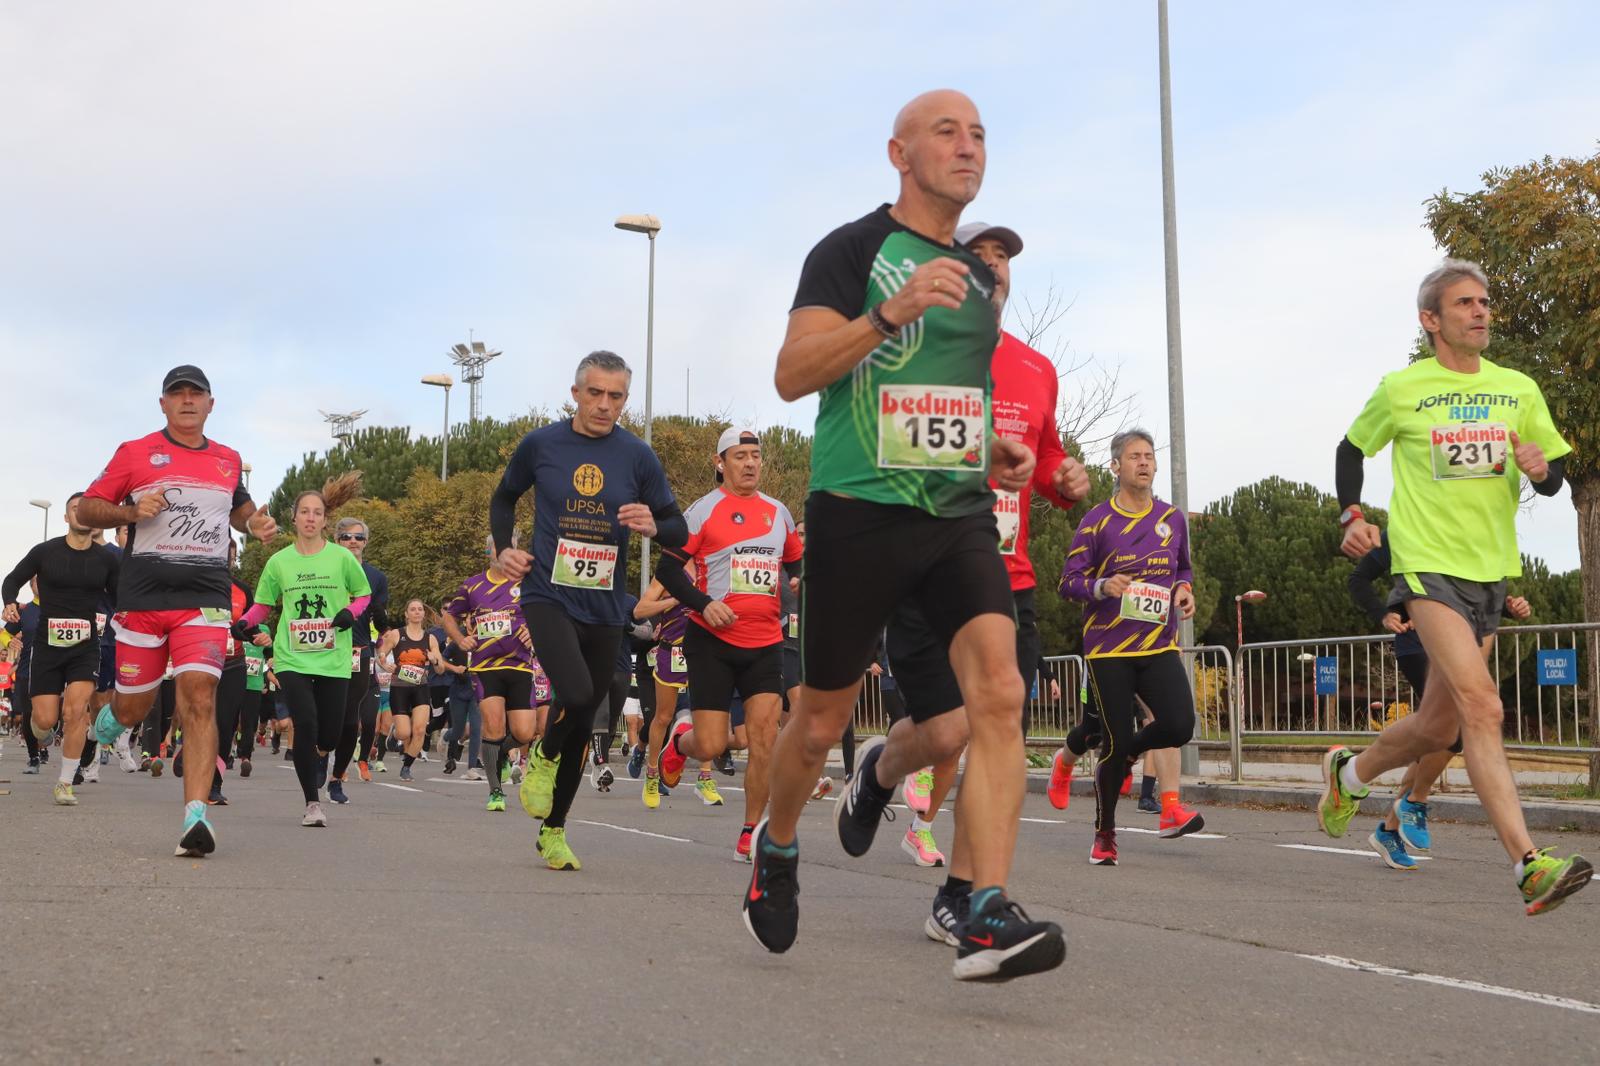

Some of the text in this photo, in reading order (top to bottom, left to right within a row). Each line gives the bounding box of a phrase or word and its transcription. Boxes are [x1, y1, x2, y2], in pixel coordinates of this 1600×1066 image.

[882, 390, 983, 417] bedunia
[1448, 405, 1490, 420] RUN
[905, 416, 967, 449] 153
[1431, 427, 1506, 446] bedunia
[1448, 443, 1493, 466] 231
[566, 499, 606, 516] UPSA
[558, 543, 616, 561] bedunia
[734, 546, 776, 555] VERGE
[574, 560, 598, 578] 95
[731, 557, 778, 572] bedunia
[742, 569, 771, 586] 162
[1133, 596, 1162, 614] 120
[49, 619, 90, 630] bedunia
[484, 620, 504, 632] 119
[56, 629, 82, 640] 281
[299, 630, 327, 644] 209
[1546, 669, 1567, 679] LOCAL
